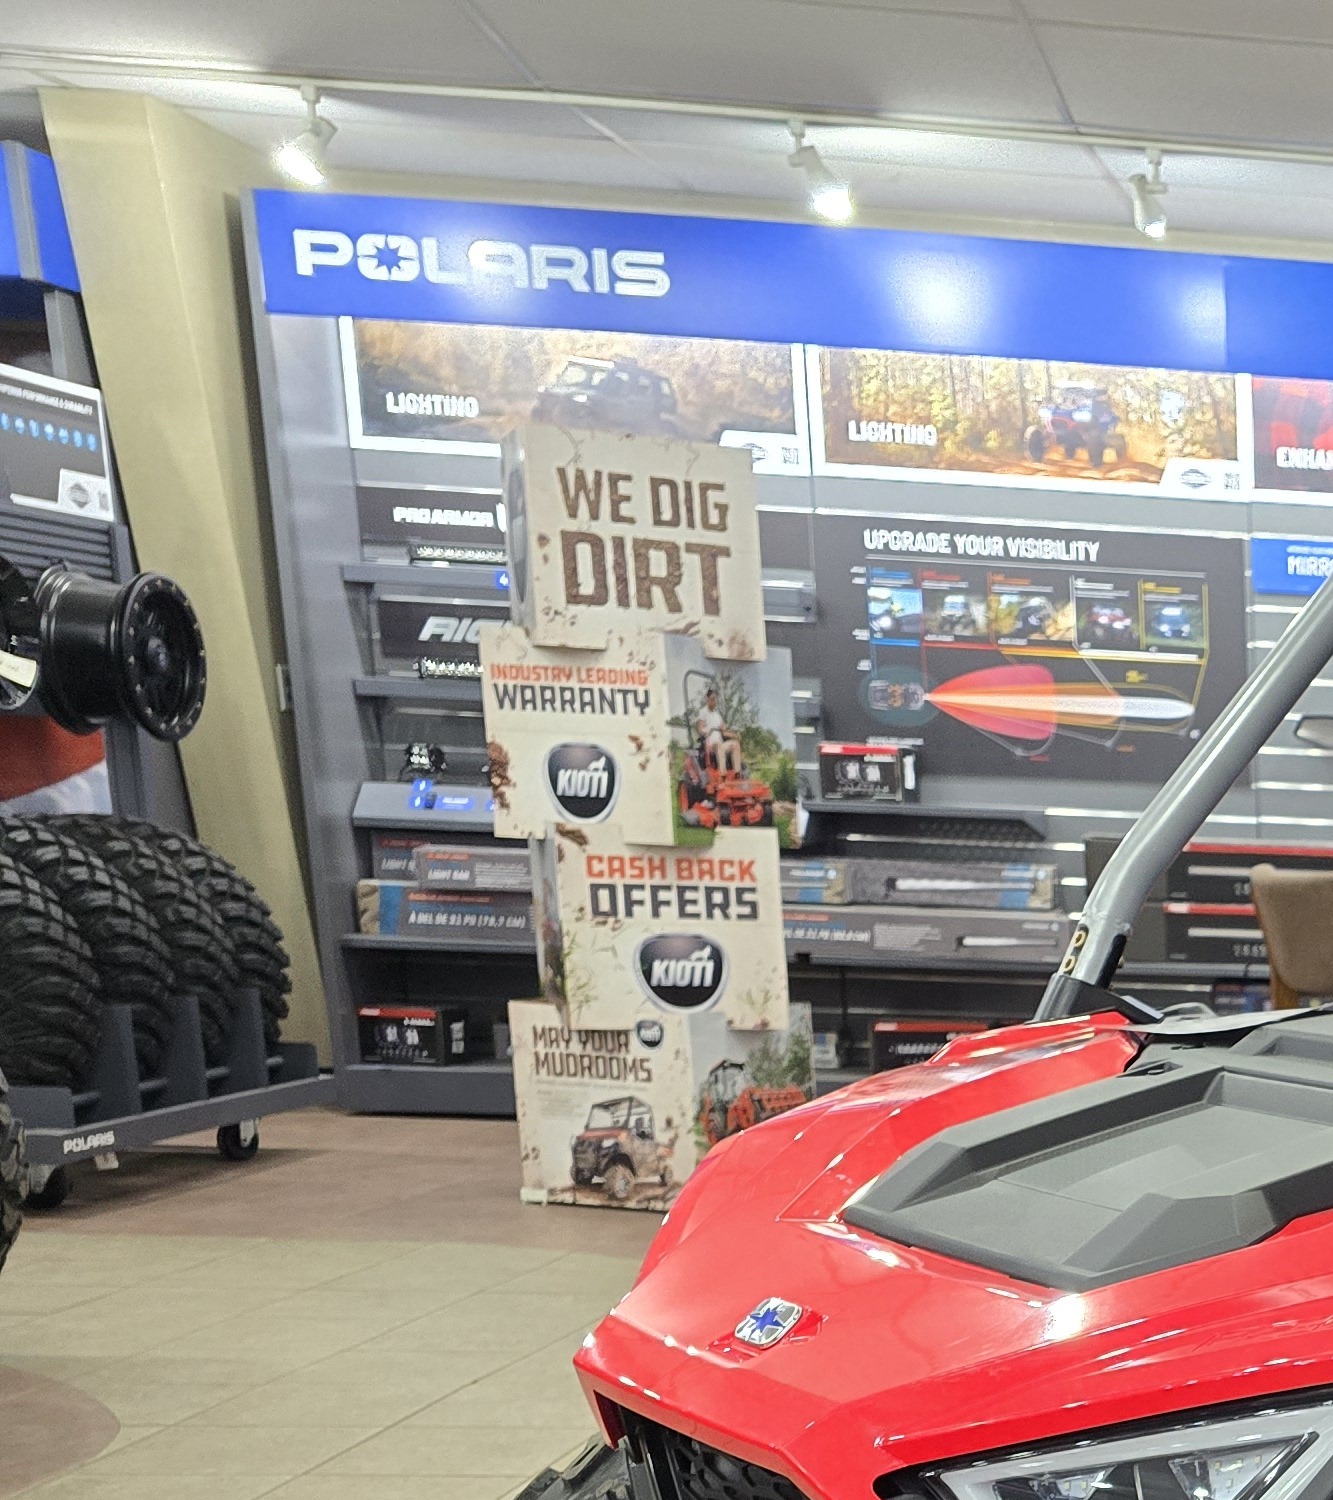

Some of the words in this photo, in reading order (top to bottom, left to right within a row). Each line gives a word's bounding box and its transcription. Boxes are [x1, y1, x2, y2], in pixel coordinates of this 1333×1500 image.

[292, 227, 671, 298] POLARIS
[385, 390, 480, 419] LIGHTING
[848, 419, 938, 447] LIGHTING
[556, 466, 637, 526] WE
[649, 475, 730, 532] DIG
[863, 528, 952, 555] UPGRADE
[953, 533, 1005, 558] YOUR
[1006, 535, 1100, 563] VISIBILITY
[560, 529, 732, 617] DIRT
[490, 662, 573, 683] INDUSTRY
[575, 665, 649, 687] LEADING
[493, 683, 650, 717] WARRANTY
[555, 765, 610, 800] KIOTI
[585, 854, 668, 881] CASH
[674, 857, 759, 883] BACK
[589, 883, 759, 920] OFFERS
[650, 956, 715, 988] KIOTI
[531, 1024, 571, 1051] MAY
[576, 1029, 631, 1054] YOUR
[533, 1051, 654, 1083] MUDROOMS
[62, 1130, 115, 1155] POLARIS
